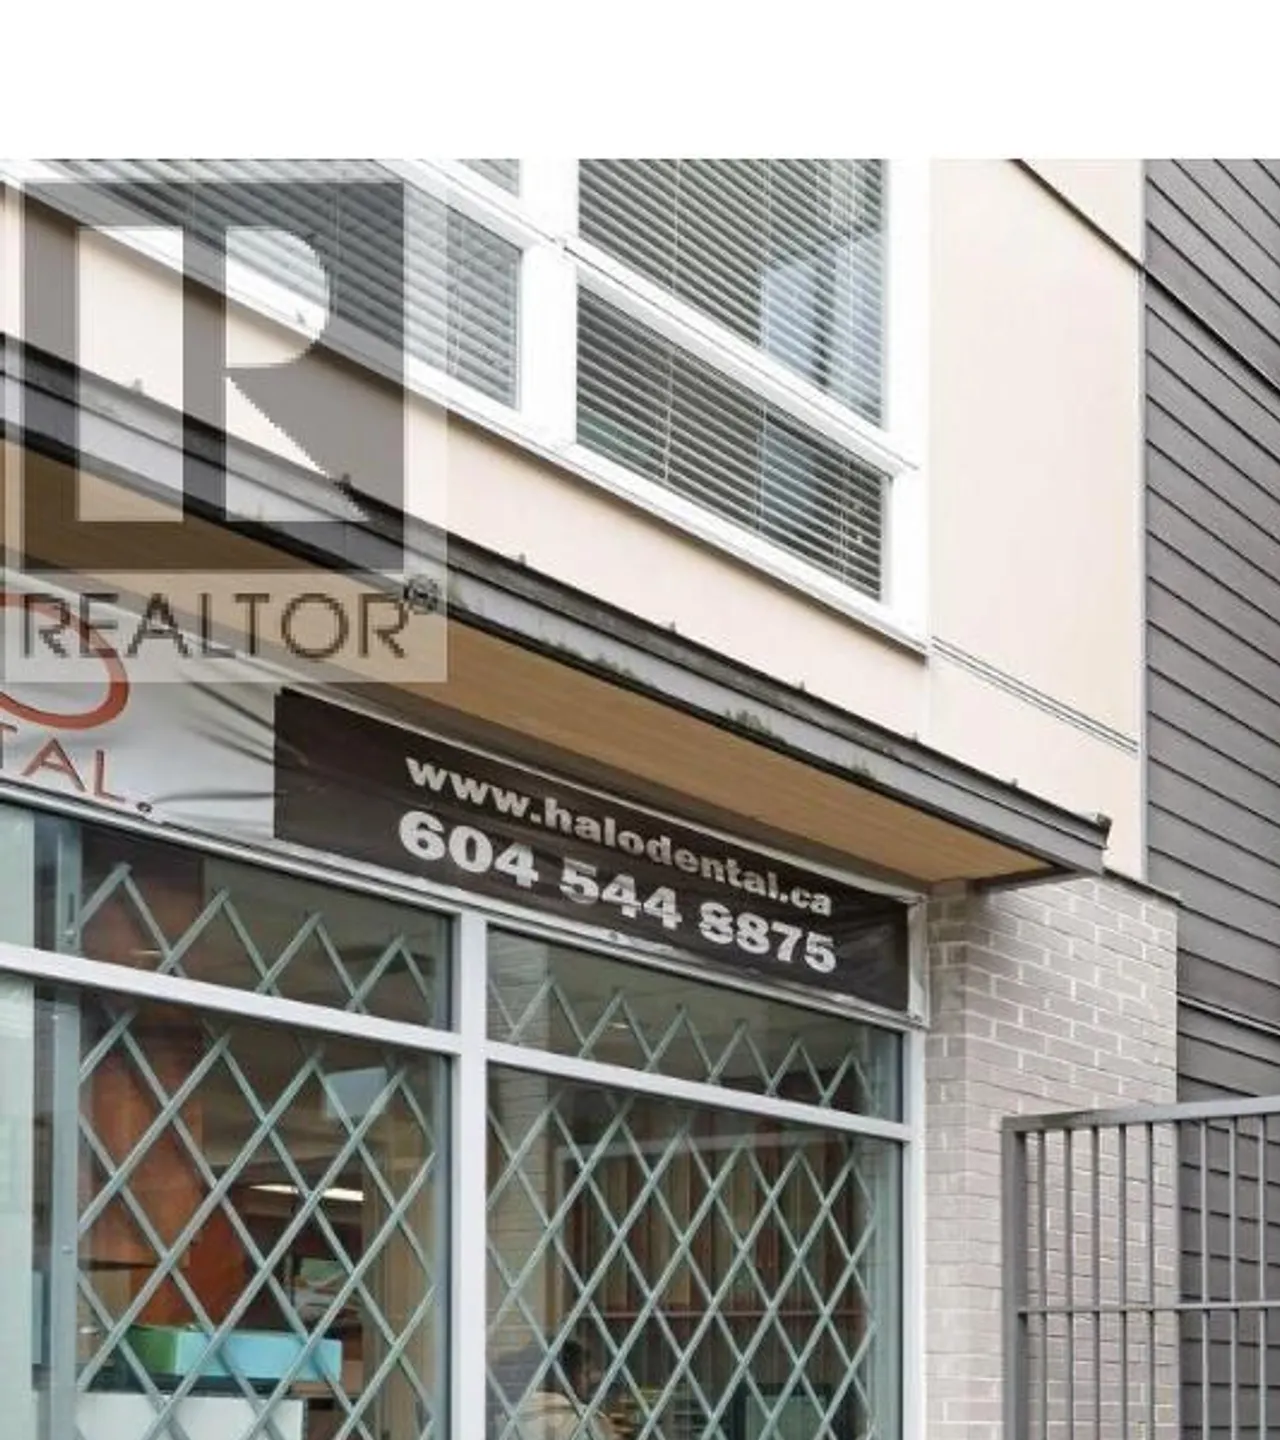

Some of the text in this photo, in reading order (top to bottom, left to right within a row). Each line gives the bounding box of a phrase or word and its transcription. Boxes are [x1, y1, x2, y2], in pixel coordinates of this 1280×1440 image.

[399, 810, 838, 974] 604 544 8875
[405, 756, 833, 916] www.halodental.ca
